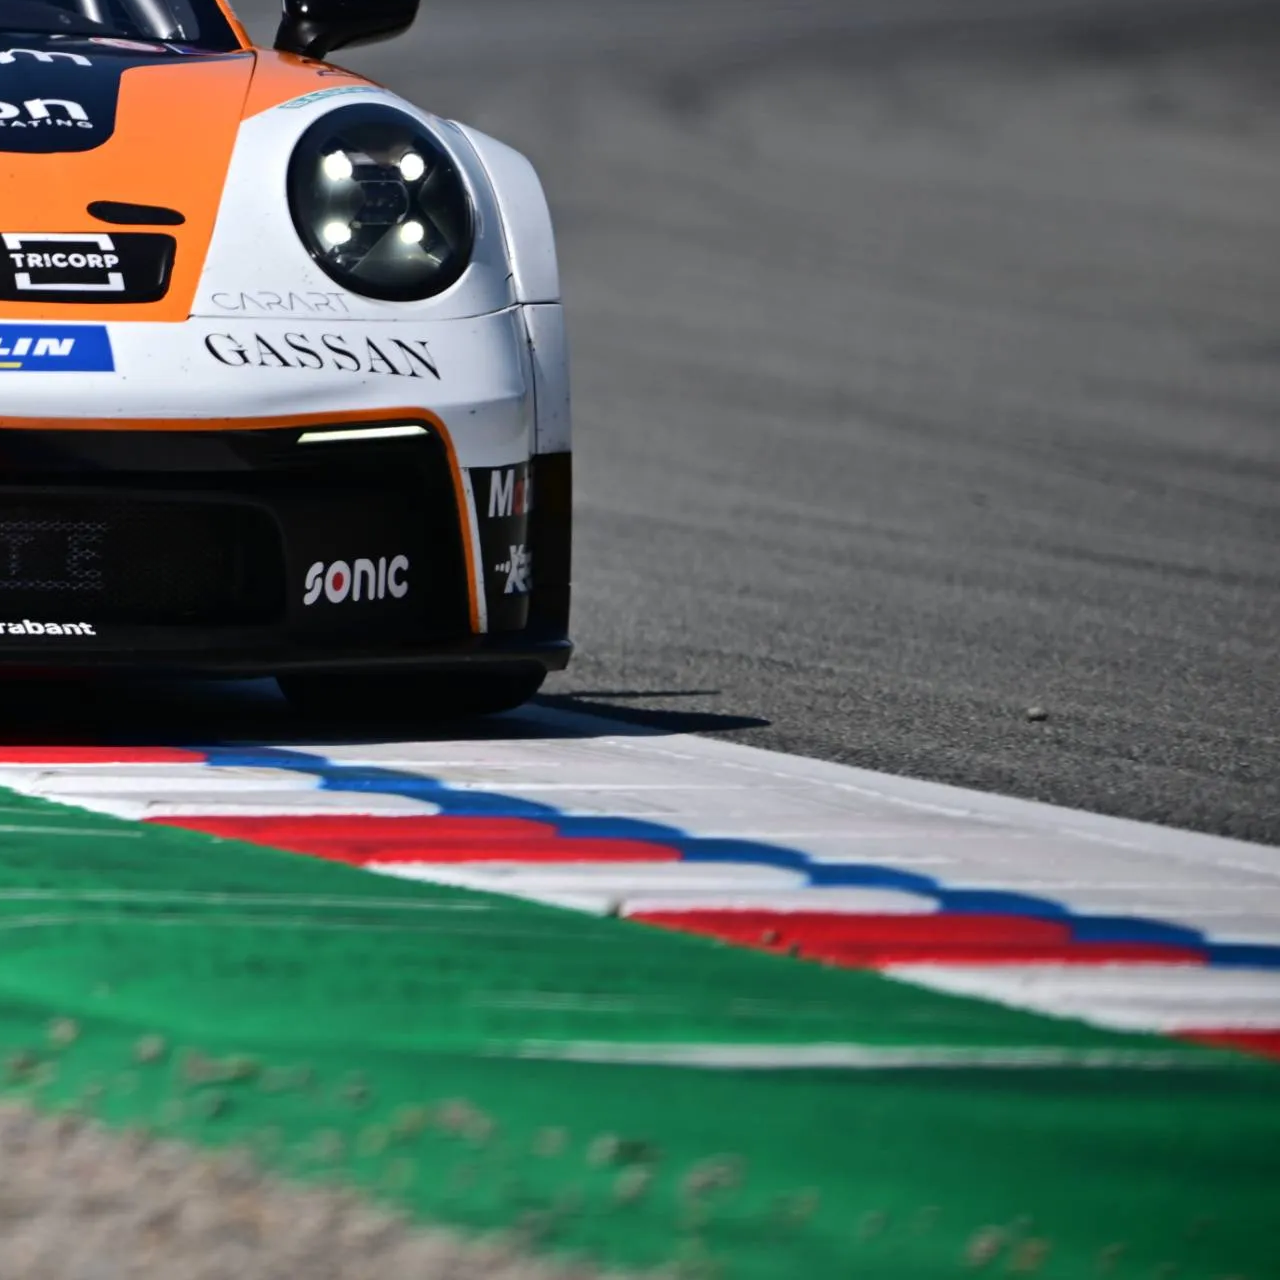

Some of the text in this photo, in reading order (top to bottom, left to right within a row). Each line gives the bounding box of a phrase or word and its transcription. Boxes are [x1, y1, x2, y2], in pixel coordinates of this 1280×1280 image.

[10, 251, 120, 270] TRICORP
[211, 291, 353, 313] CARART
[205, 332, 441, 379] GASSAN
